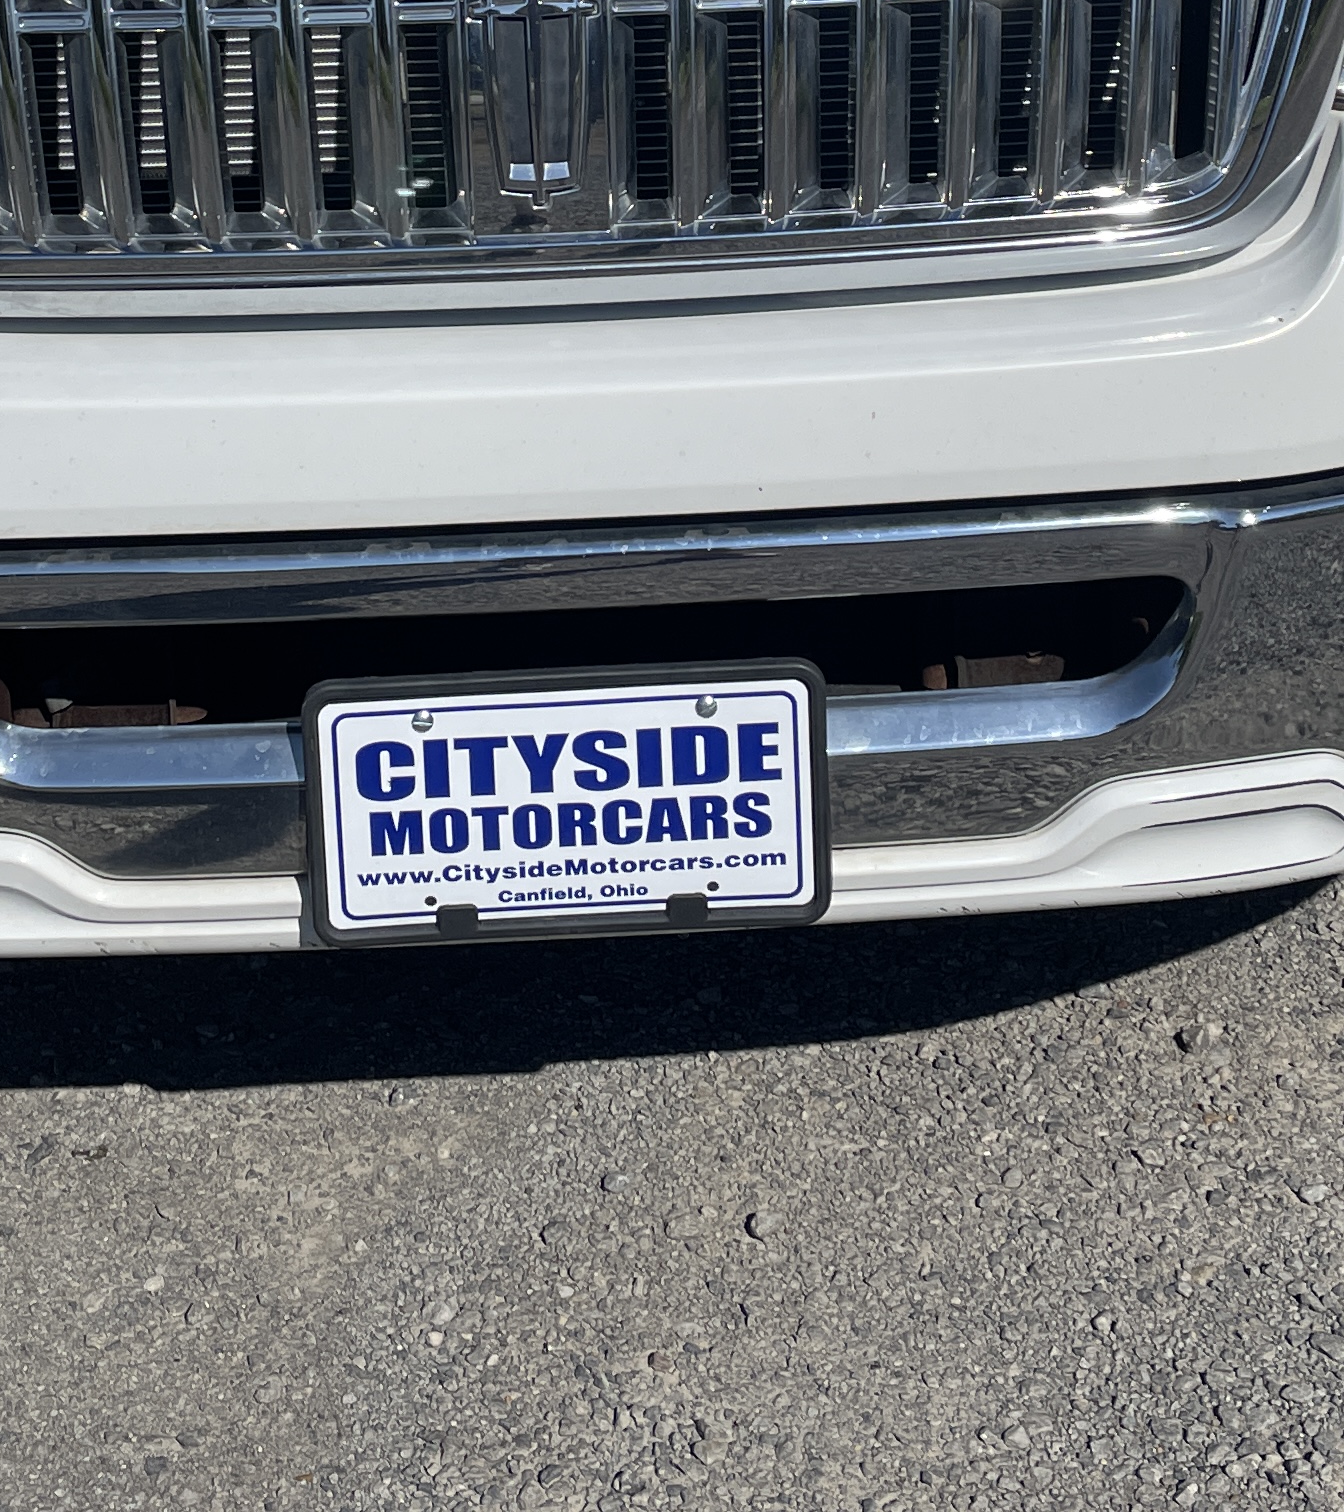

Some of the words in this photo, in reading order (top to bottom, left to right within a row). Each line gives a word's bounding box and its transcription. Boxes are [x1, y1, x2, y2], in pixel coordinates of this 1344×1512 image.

[355, 721, 784, 802] CITYSIDE
[369, 791, 773, 857] MOTORCARS
[357, 850, 788, 887] www.CitysideMotorcars.com
[497, 884, 593, 904] Canfield,
[600, 883, 649, 899] Ohio
